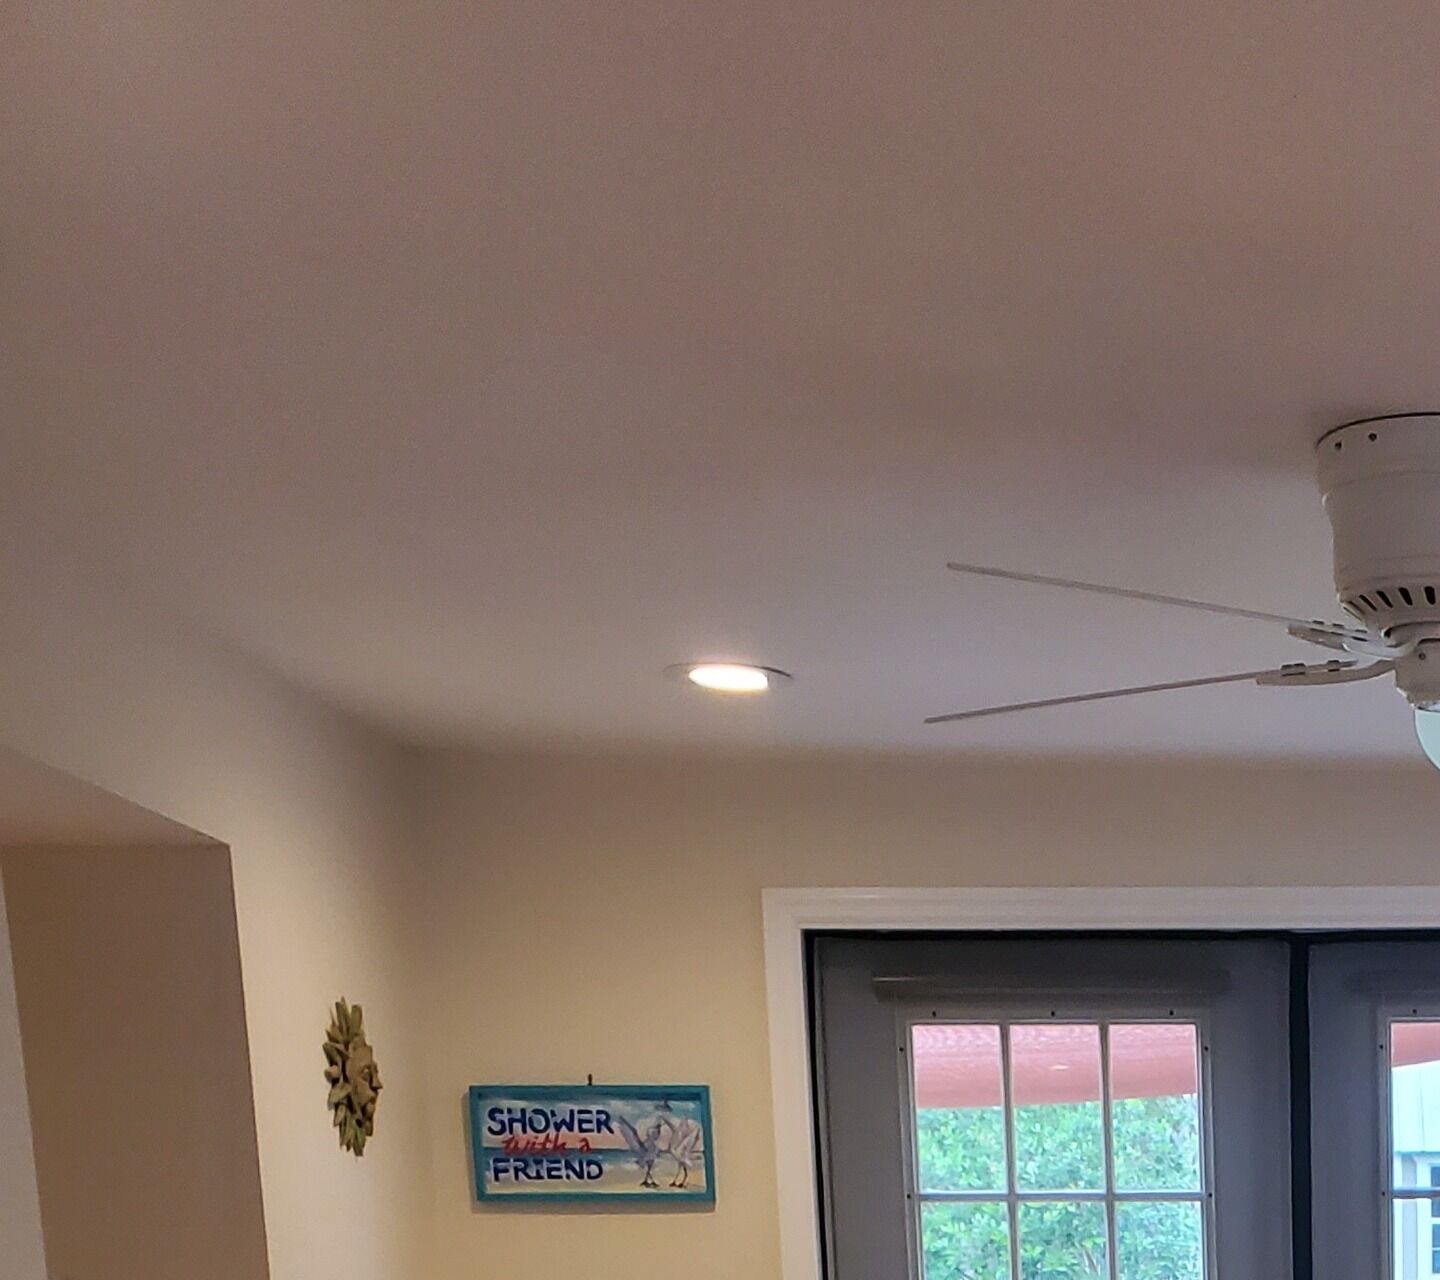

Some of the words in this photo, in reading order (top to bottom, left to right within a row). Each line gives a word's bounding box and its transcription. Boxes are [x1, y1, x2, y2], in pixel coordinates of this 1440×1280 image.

[487, 1107, 614, 1135] SHOWER
[502, 1132, 567, 1156] with
[578, 1136, 592, 1153] a
[492, 1157, 603, 1181] FRIEND
